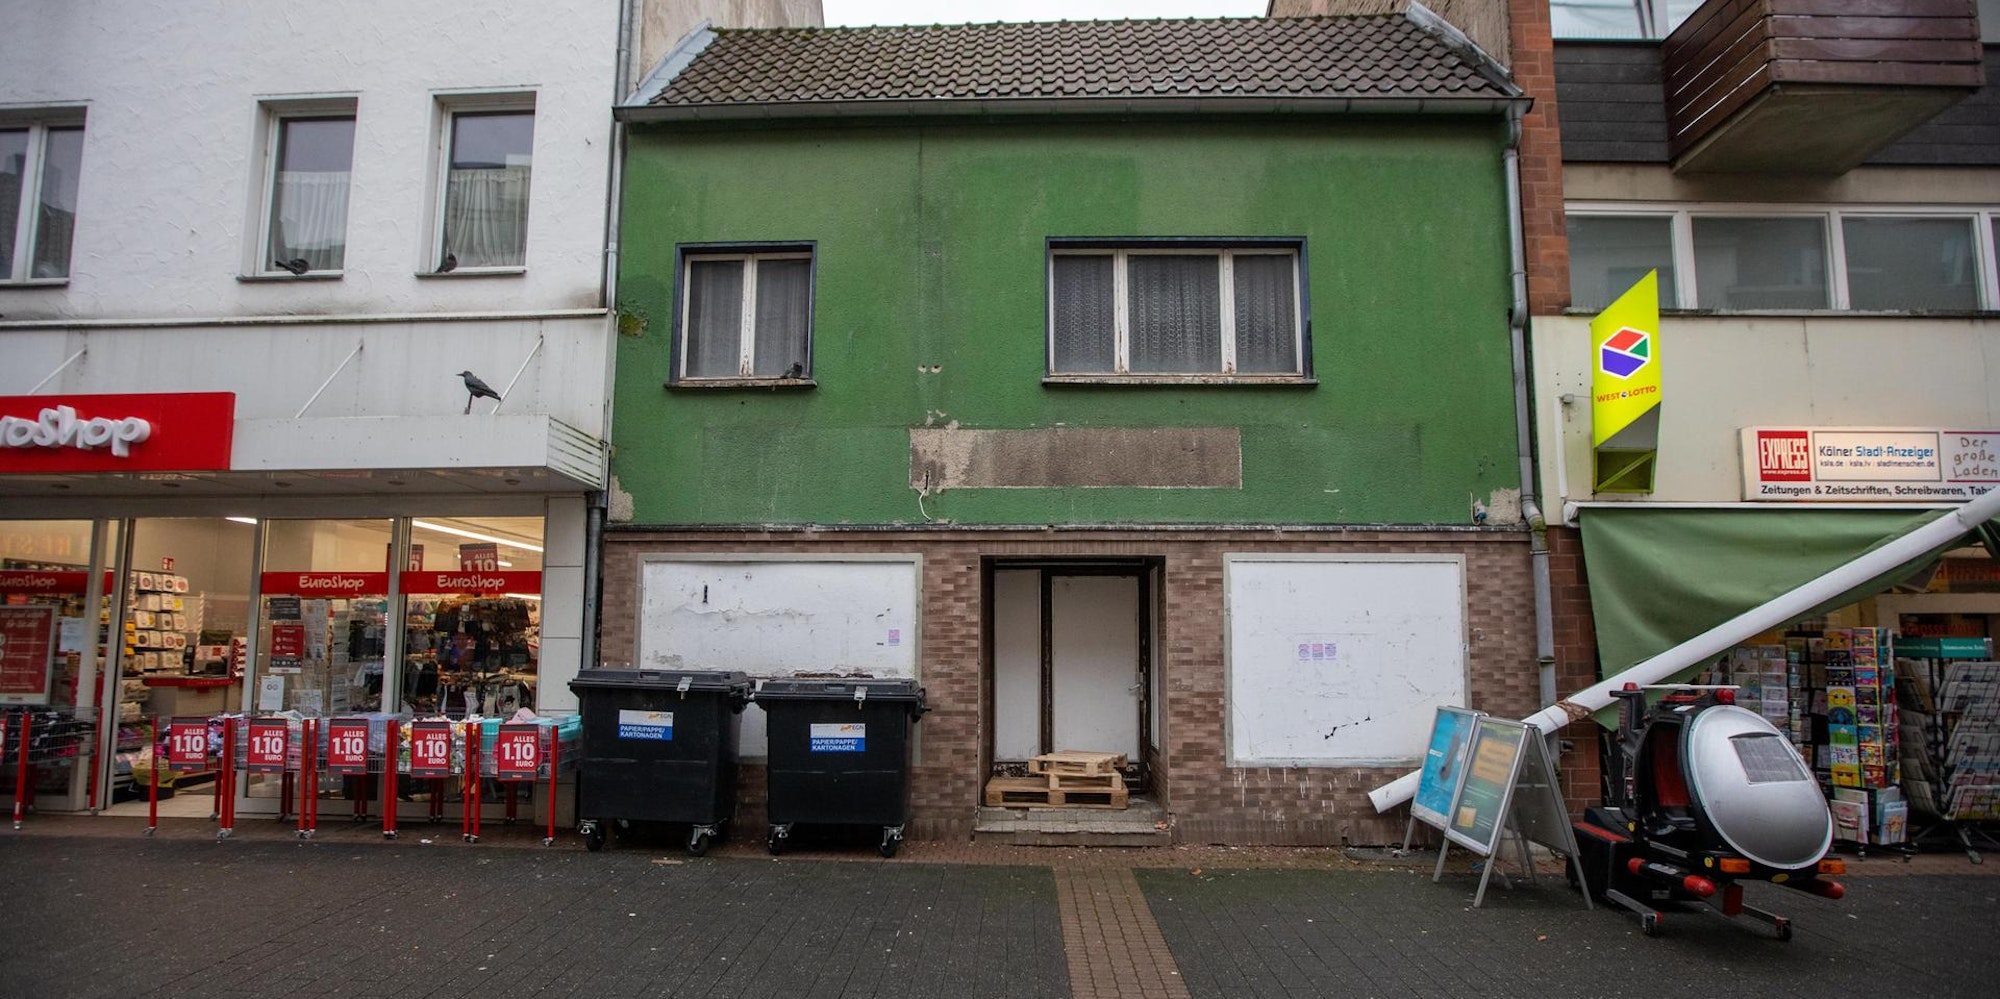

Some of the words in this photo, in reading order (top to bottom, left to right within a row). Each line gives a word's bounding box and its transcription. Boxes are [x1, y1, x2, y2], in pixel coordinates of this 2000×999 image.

[1597, 392, 1620, 402] WEST
[1629, 385, 1656, 397] LOTTO
[1960, 437, 1988, 448] Der
[1760, 438, 1808, 469] EXPRESS
[1819, 446, 1852, 457] Kölner
[1856, 446, 1934, 460] Stadt-Anzeiger
[1954, 449, 1995, 466] große
[1953, 463, 1998, 478] Laden
[1761, 485, 1811, 497] Zeitungen
[1814, 485, 1822, 495] &
[1825, 485, 1892, 496] Zeitschriften,
[1894, 485, 1966, 496] Schreibwaren,
[299, 574, 365, 591] EuroShop
[437, 574, 505, 591] EuroShop
[343, 730, 365, 738] ALLES
[620, 725, 666, 733] PAPIER/PAPPE/
[620, 731, 663, 739] KARTONAGEN
[173, 735, 205, 752] 1.10
[252, 737, 284, 754] 1.10
[332, 737, 365, 755] 1.10
[513, 735, 535, 743] ALLES
[415, 740, 447, 758] 1.10
[502, 742, 535, 760] 1.10
[345, 754, 364, 762] EURO
[428, 757, 447, 765] EURO
[515, 760, 535, 768] EURO
